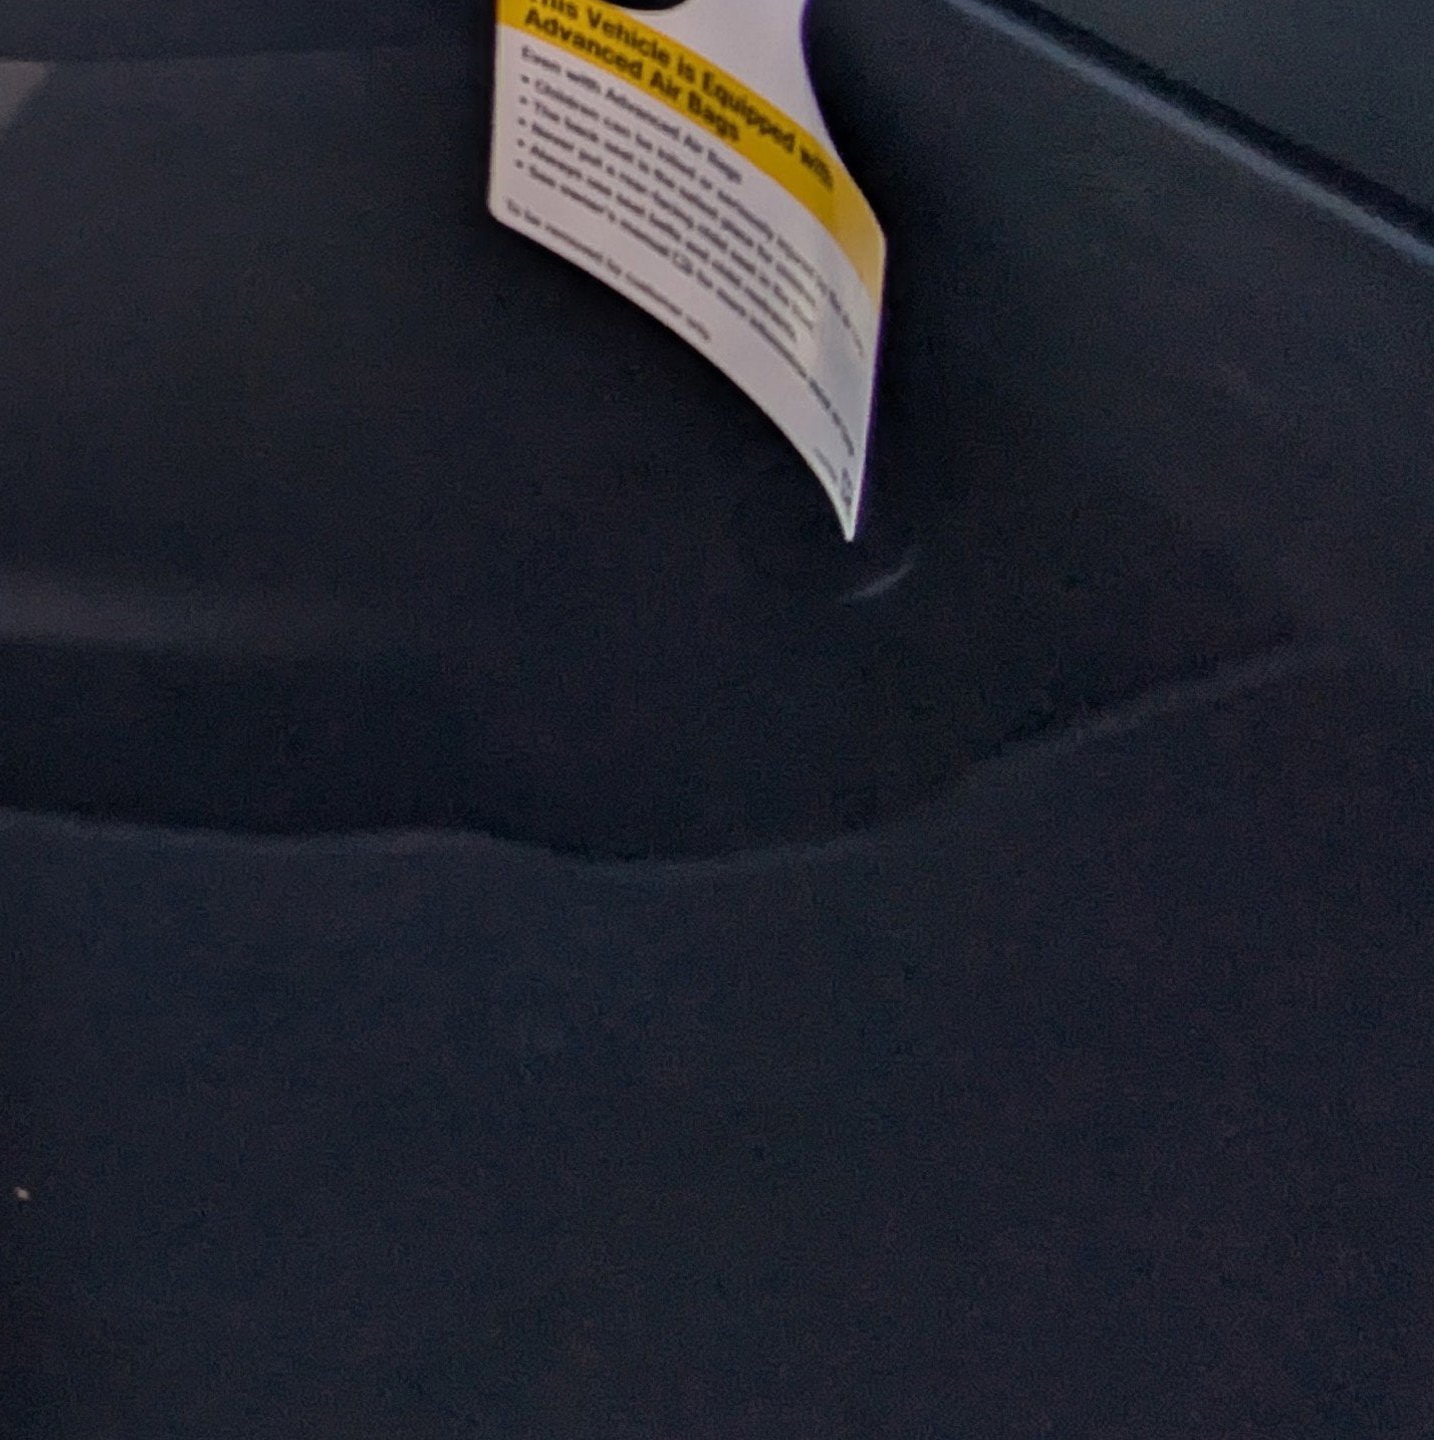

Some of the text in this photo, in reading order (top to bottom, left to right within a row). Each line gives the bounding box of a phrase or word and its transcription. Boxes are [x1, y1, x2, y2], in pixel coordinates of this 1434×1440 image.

[521, 45, 742, 185] Even with Advanced Air Bags
[525, 8, 741, 142] Advanced Air Bags
[586, 7, 672, 66] Vehicle
[676, 54, 697, 85] is
[702, 70, 798, 153] Equipped
[799, 149, 835, 192] with
